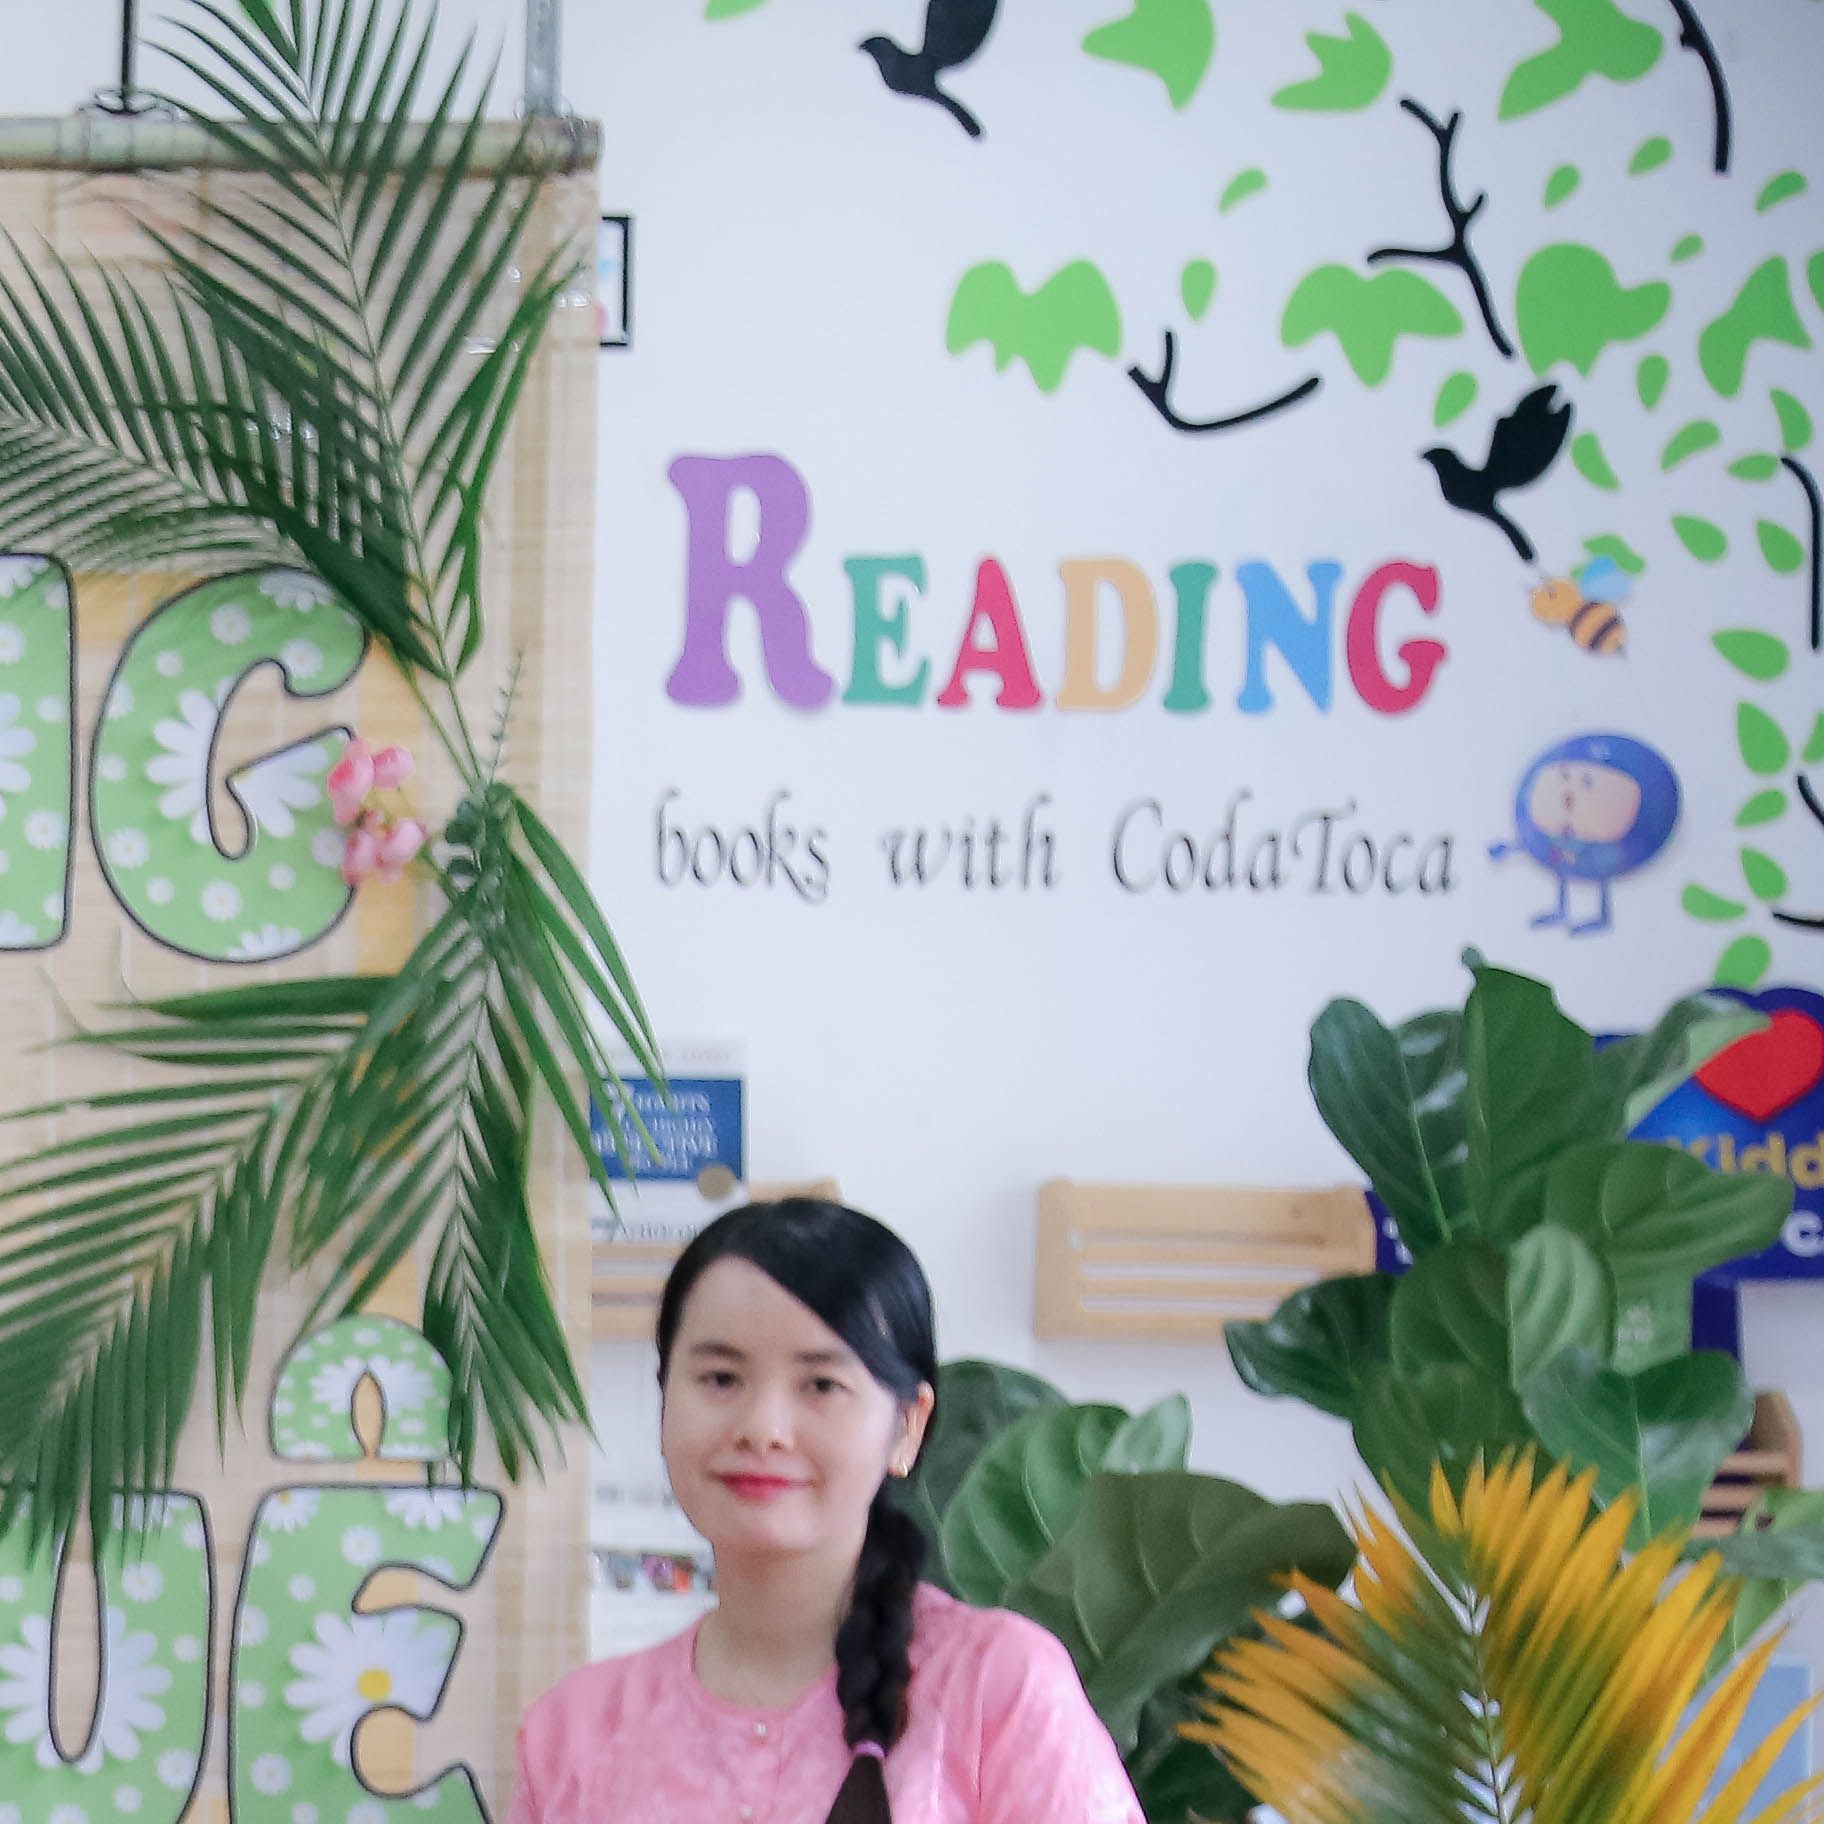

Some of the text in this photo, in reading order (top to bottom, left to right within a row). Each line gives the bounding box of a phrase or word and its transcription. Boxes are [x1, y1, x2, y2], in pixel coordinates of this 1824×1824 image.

[665, 452, 1448, 716] READING
[652, 788, 830, 904] books
[881, 790, 1063, 893] with
